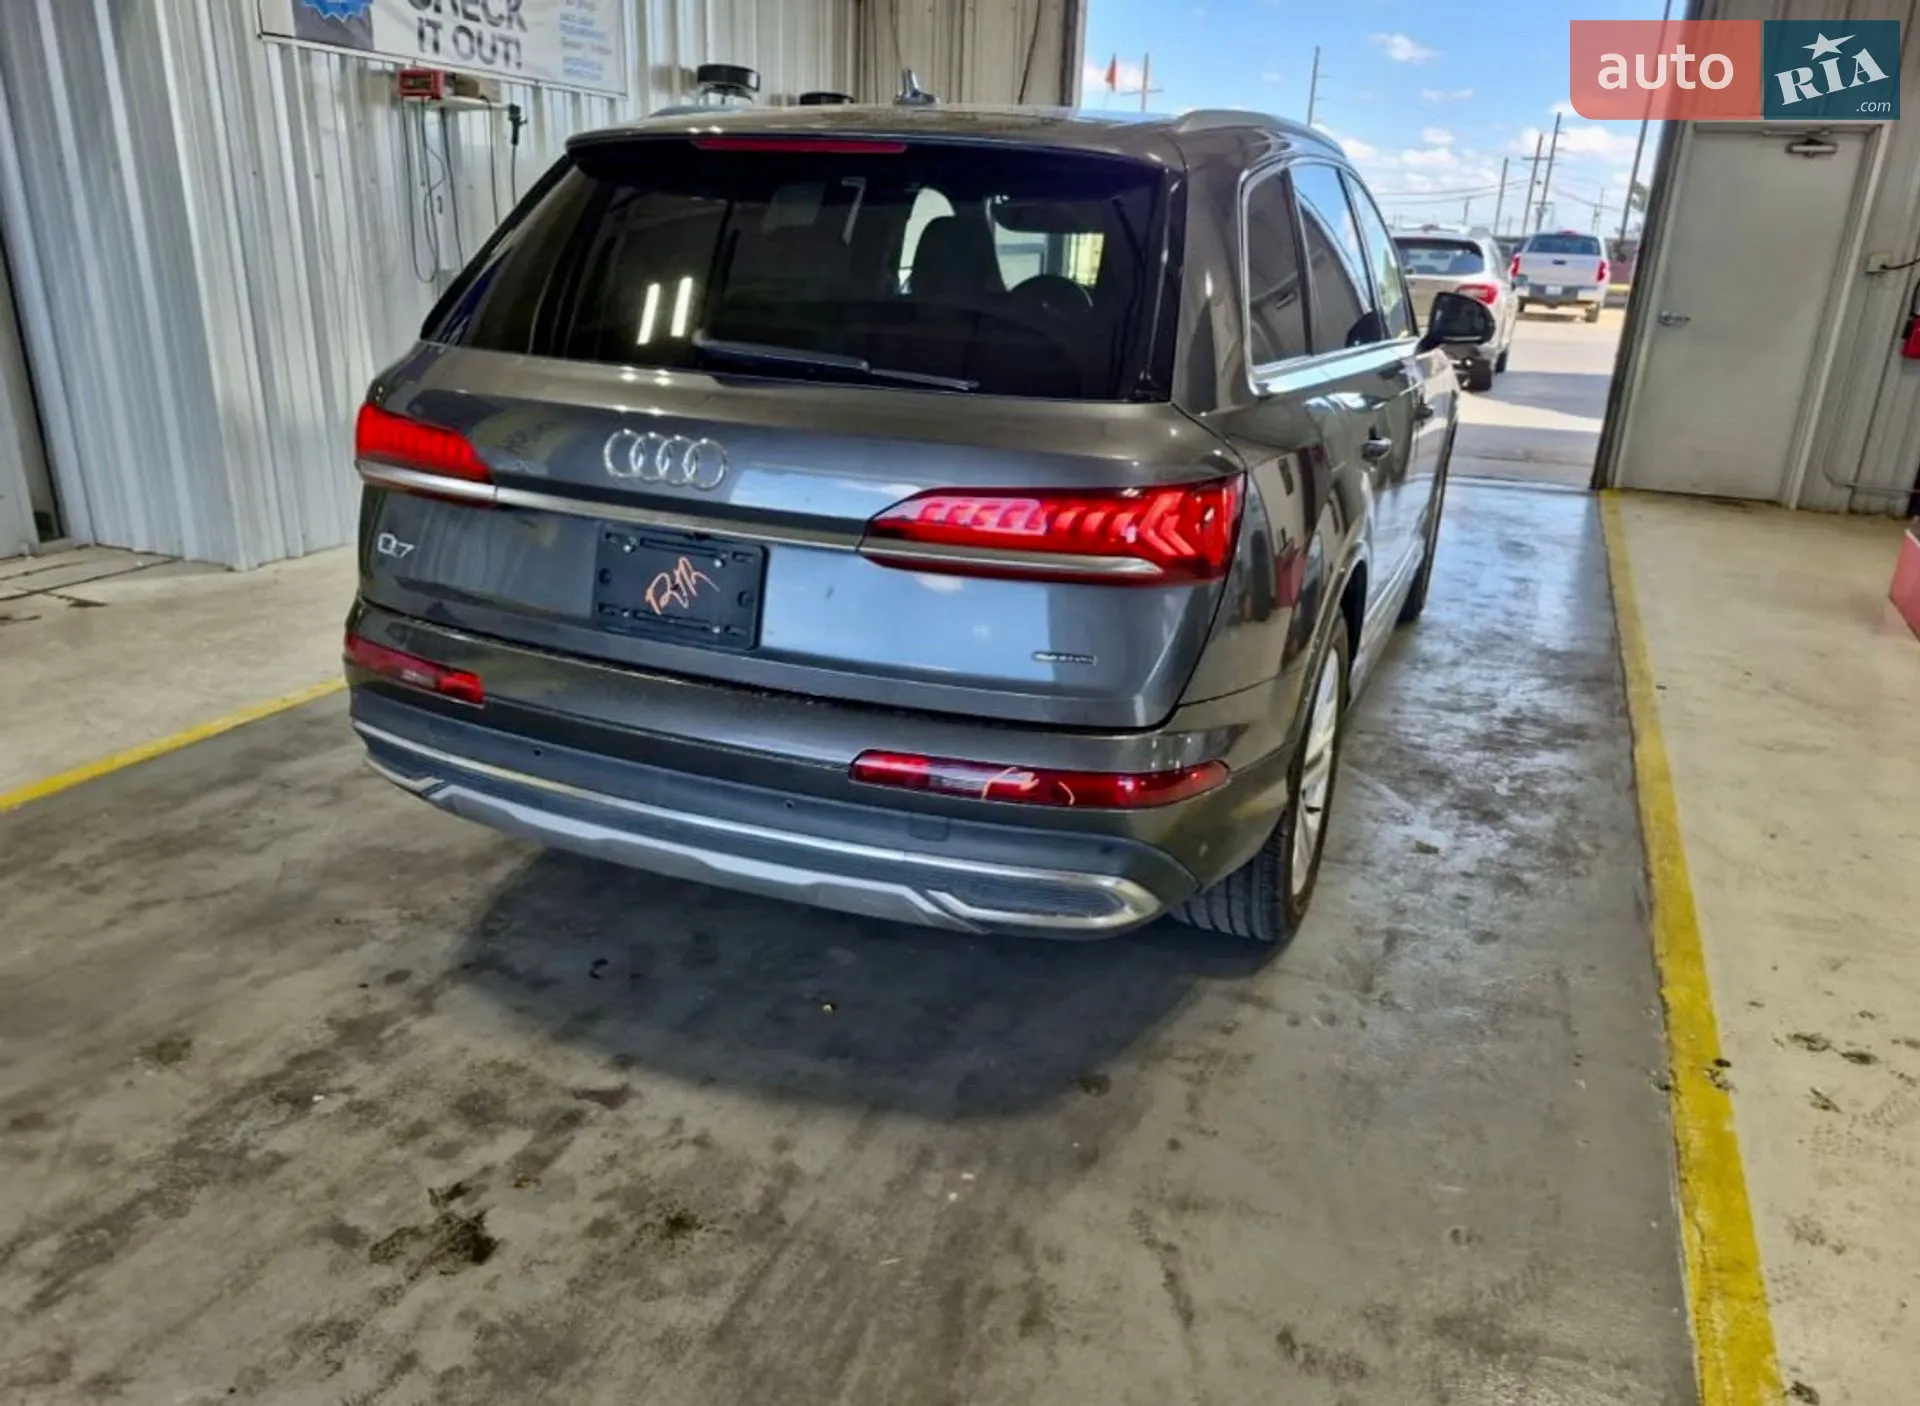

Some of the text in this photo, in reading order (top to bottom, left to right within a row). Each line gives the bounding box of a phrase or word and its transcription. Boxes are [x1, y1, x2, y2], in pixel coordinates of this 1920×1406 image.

[417, 16, 443, 54] IT
[452, 24, 522, 70] OUT!
[378, 532, 414, 558] Q7
